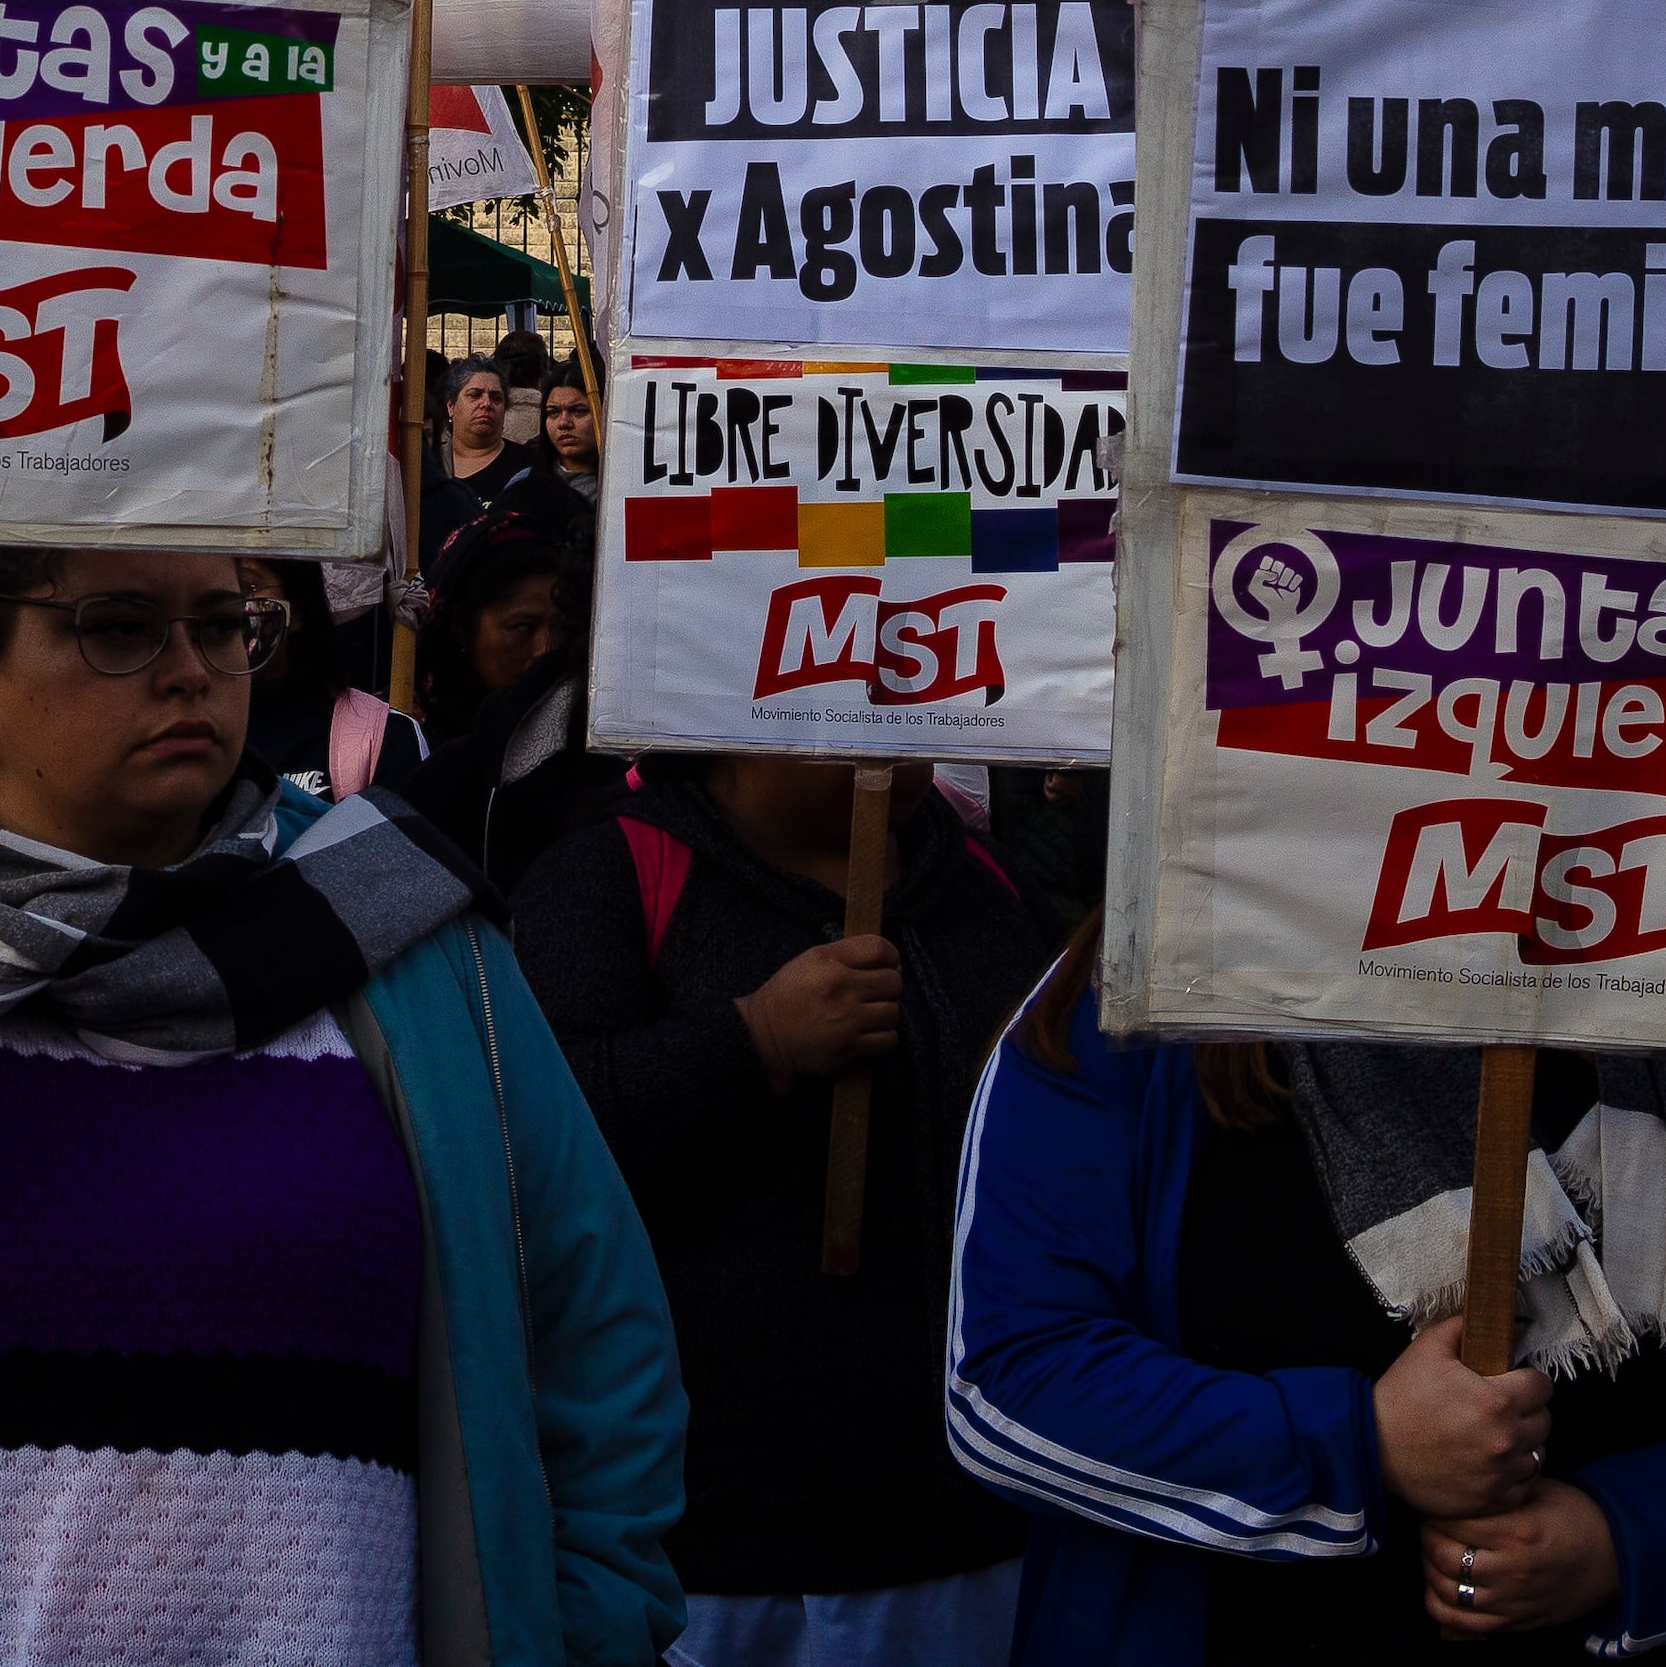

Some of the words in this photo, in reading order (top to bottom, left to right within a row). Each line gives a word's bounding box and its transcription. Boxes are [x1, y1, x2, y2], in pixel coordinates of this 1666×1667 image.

[201, 40, 226, 79] y
[241, 42, 270, 82] a
[287, 42, 327, 85] la
[704, 1, 1110, 126] JUSTICIA
[1214, 66, 1321, 196] Ni
[1346, 96, 1547, 201] una
[656, 188, 712, 282] x
[732, 155, 1135, 302] Agostina
[1228, 235, 1404, 367] fue
[17, 450, 130, 477] Trabajadores
[642, 381, 792, 486] LIBRE
[780, 592, 1006, 694] MST
[751, 707, 822, 722] Movimiento
[825, 709, 883, 724] Socialista
[886, 711, 903, 725] de
[905, 712, 924, 726] los
[926, 712, 1005, 731] Trabajadores
[1358, 958, 1454, 984] Movimiento
[1459, 968, 1538, 990] Socialista
[1541, 972, 1563, 990] de
[1567, 972, 1591, 991] los
